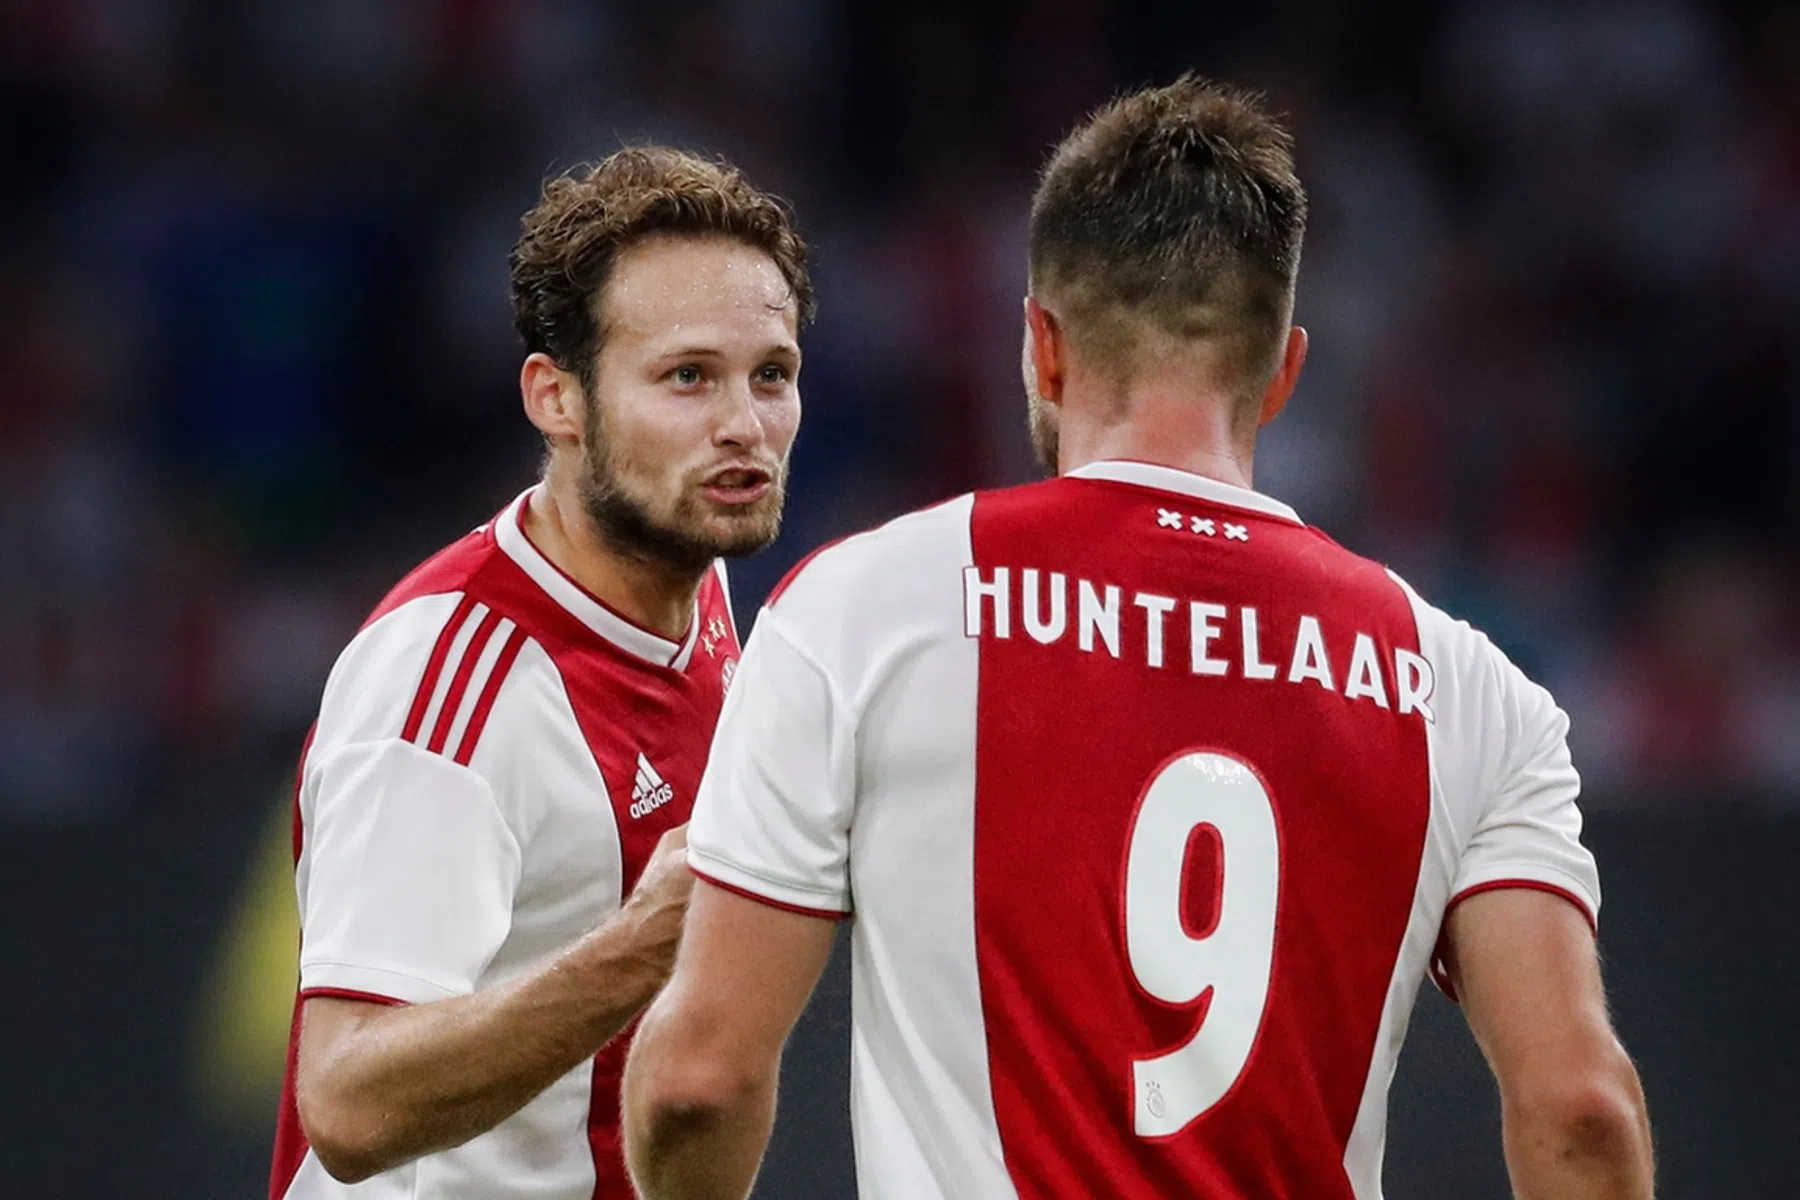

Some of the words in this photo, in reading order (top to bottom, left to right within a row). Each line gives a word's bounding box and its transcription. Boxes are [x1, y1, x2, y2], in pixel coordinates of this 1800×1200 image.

[964, 565, 1435, 723] HUNTELAAR
[630, 783, 673, 818] adidas
[1125, 751, 1281, 1137] 9
